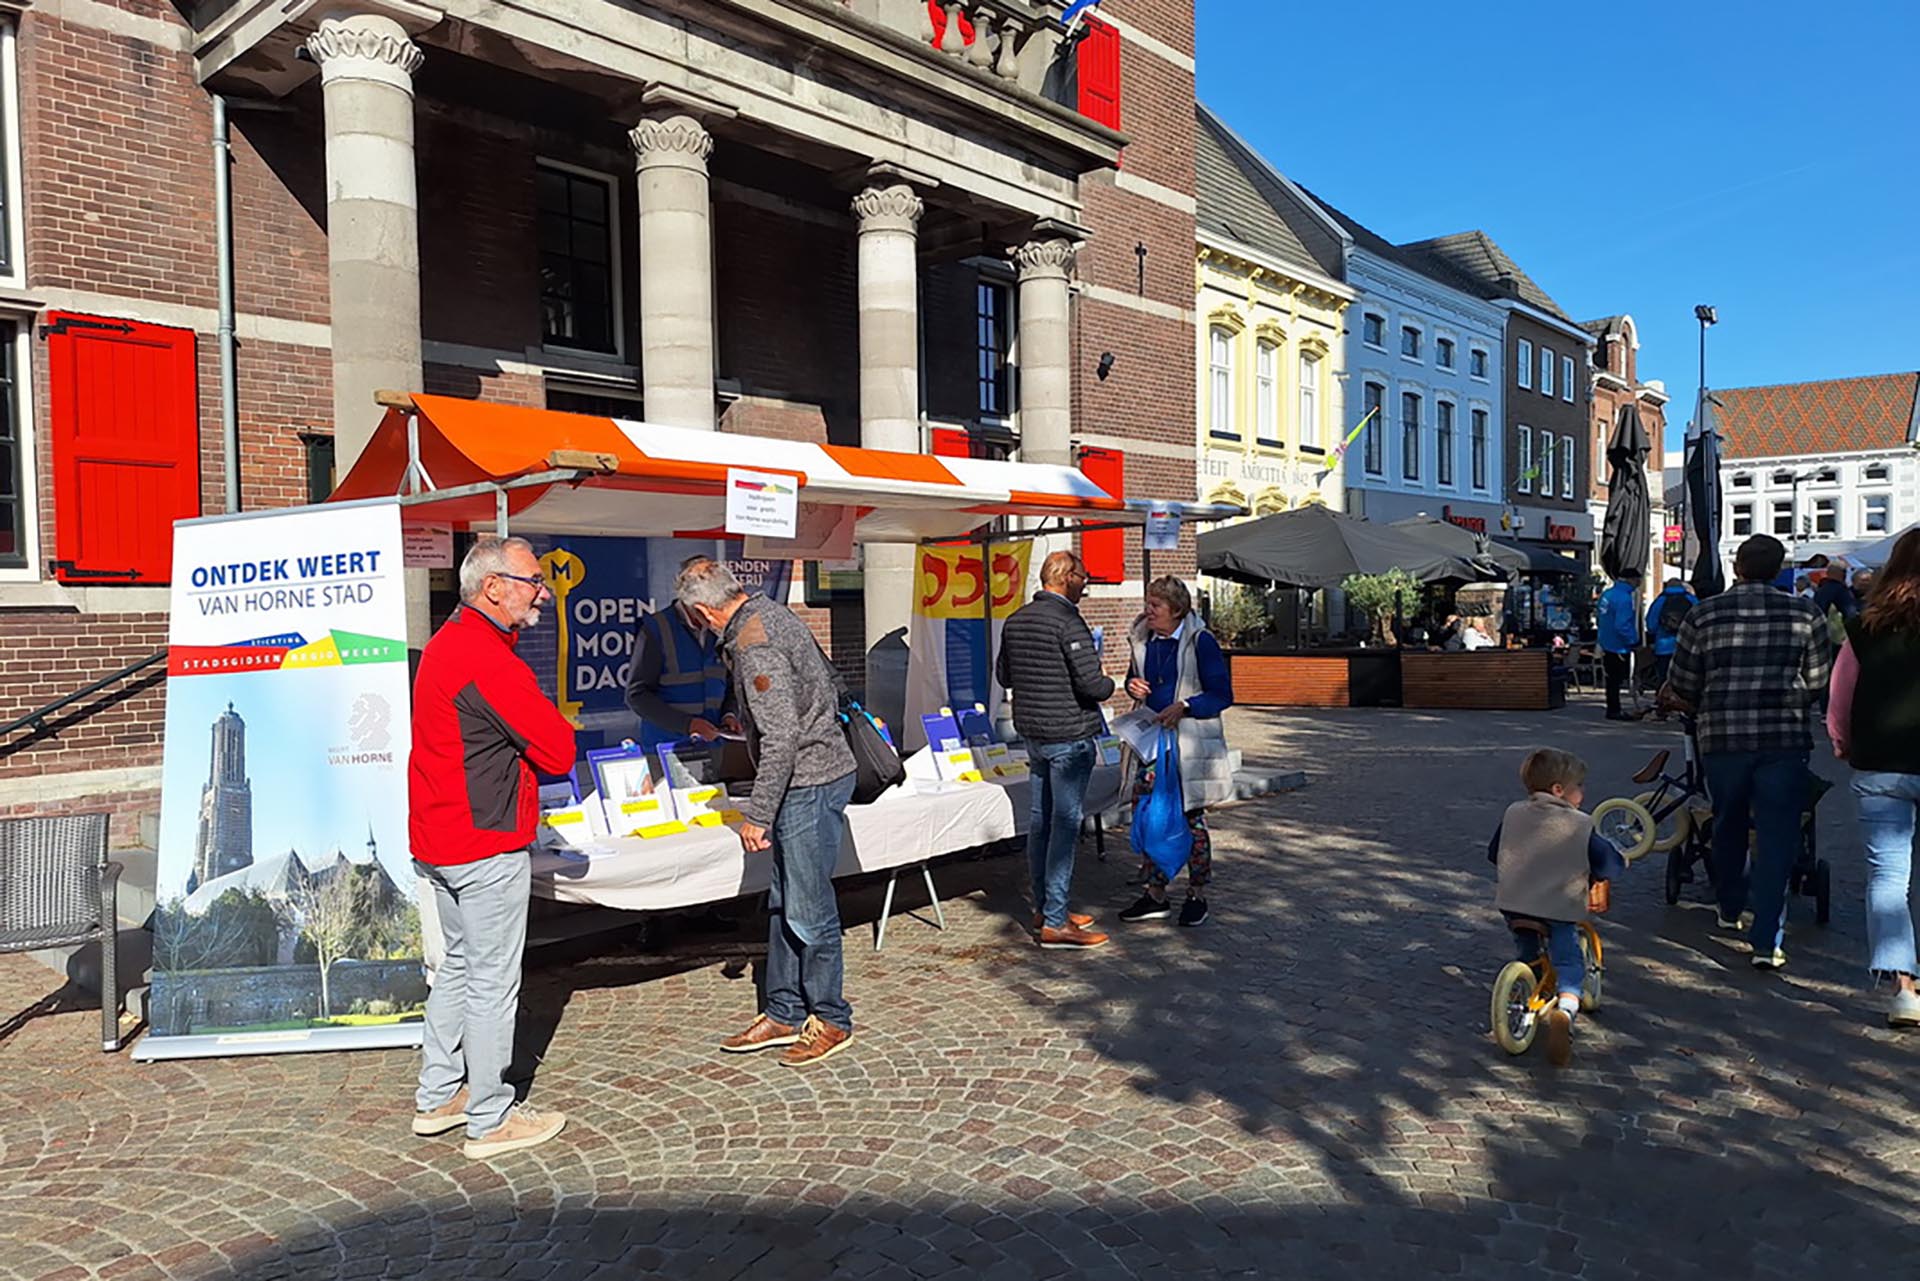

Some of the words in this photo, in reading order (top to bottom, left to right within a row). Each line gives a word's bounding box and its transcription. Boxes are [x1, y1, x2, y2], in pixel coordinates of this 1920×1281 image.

[191, 559, 289, 588] ONTDEK
[297, 550, 381, 578] WEERT
[198, 596, 239, 616] VAN
[245, 588, 316, 612] HORNE
[323, 582, 374, 606] STAD
[574, 598, 656, 625] OPEN
[183, 654, 281, 669] STADSGIDSEN
[291, 651, 335, 662] REGIO
[341, 646, 390, 658] WEERT
[328, 755, 350, 765] VAN
[352, 752, 393, 764] HORNE
